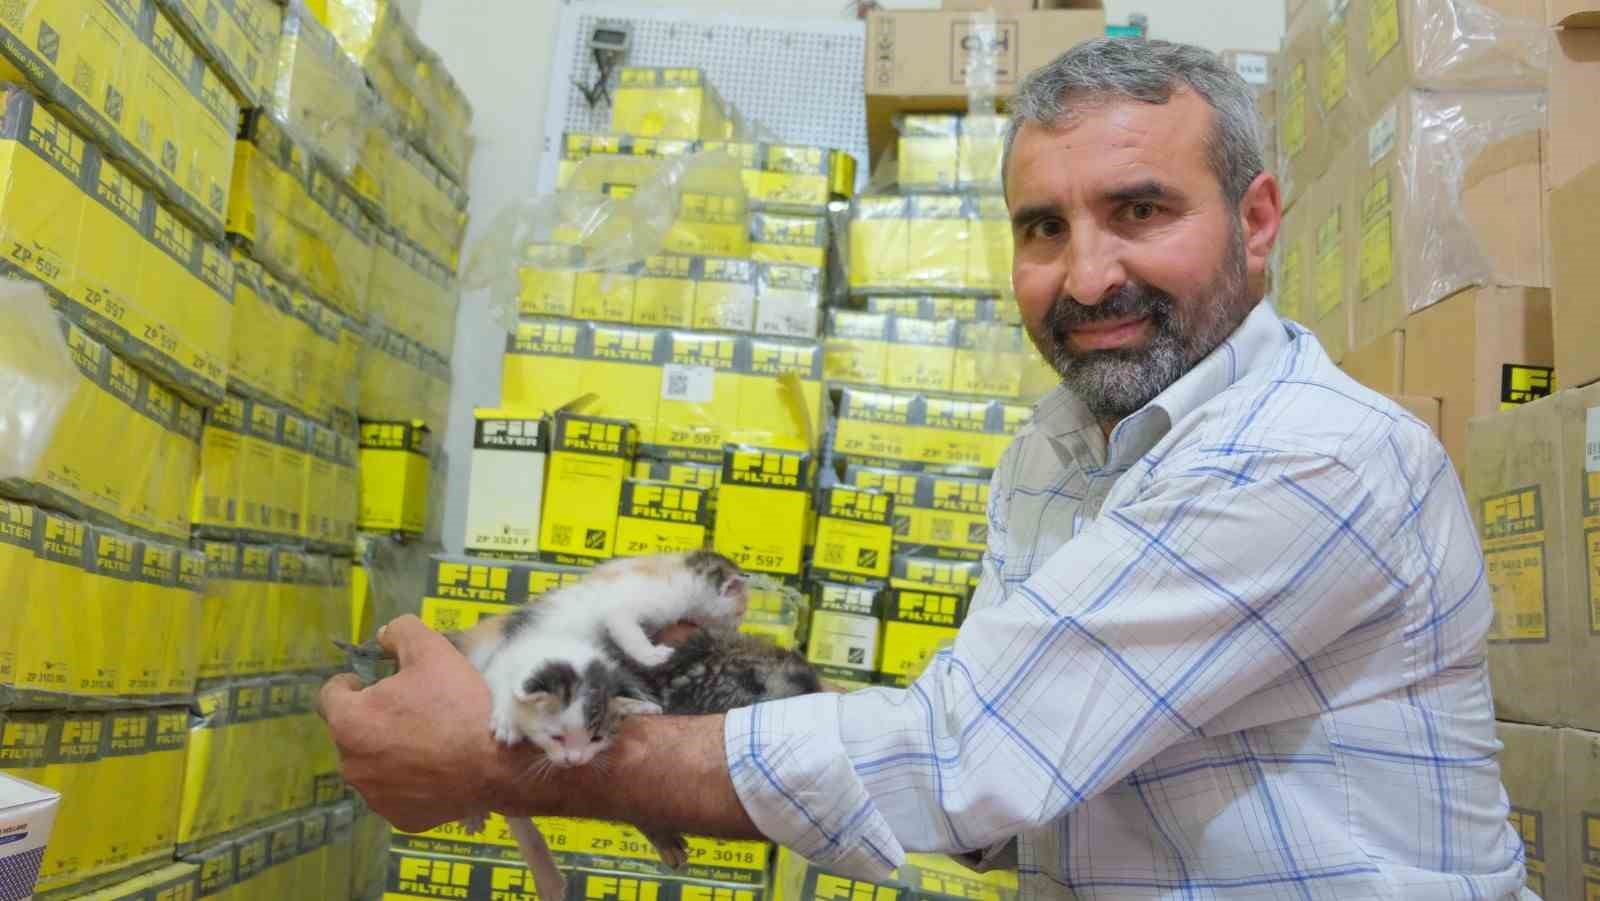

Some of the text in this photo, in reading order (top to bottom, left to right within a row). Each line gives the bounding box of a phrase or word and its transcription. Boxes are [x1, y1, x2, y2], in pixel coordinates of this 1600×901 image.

[755, 555, 785, 567] 597
[591, 837, 613, 849] ZP
[712, 849, 754, 863] 3018
